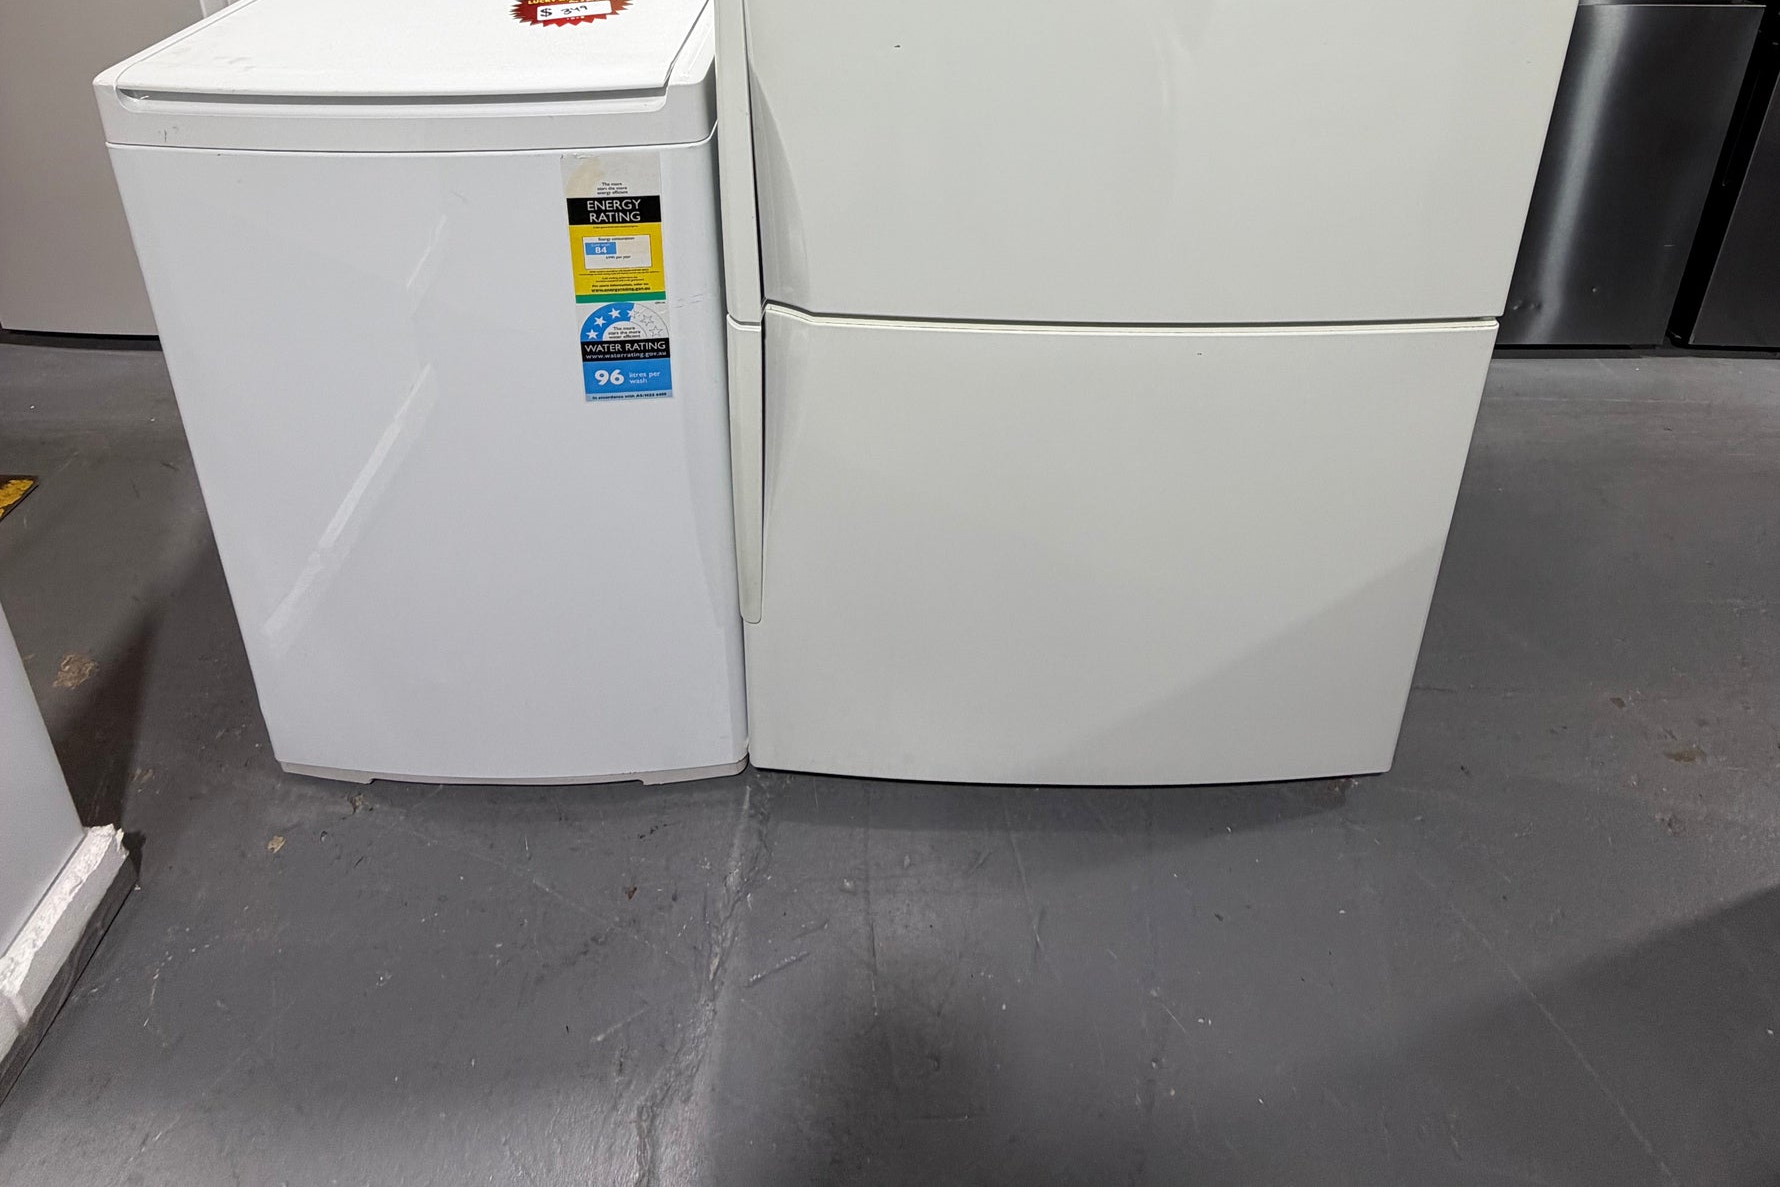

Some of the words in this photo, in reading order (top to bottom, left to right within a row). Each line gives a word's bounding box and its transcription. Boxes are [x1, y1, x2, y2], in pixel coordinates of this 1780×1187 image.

[587, 199, 641, 211] ENERGY
[589, 211, 641, 223] RATING
[585, 343, 622, 353] WATER
[625, 341, 666, 351] RATING
[594, 369, 625, 386] 96
